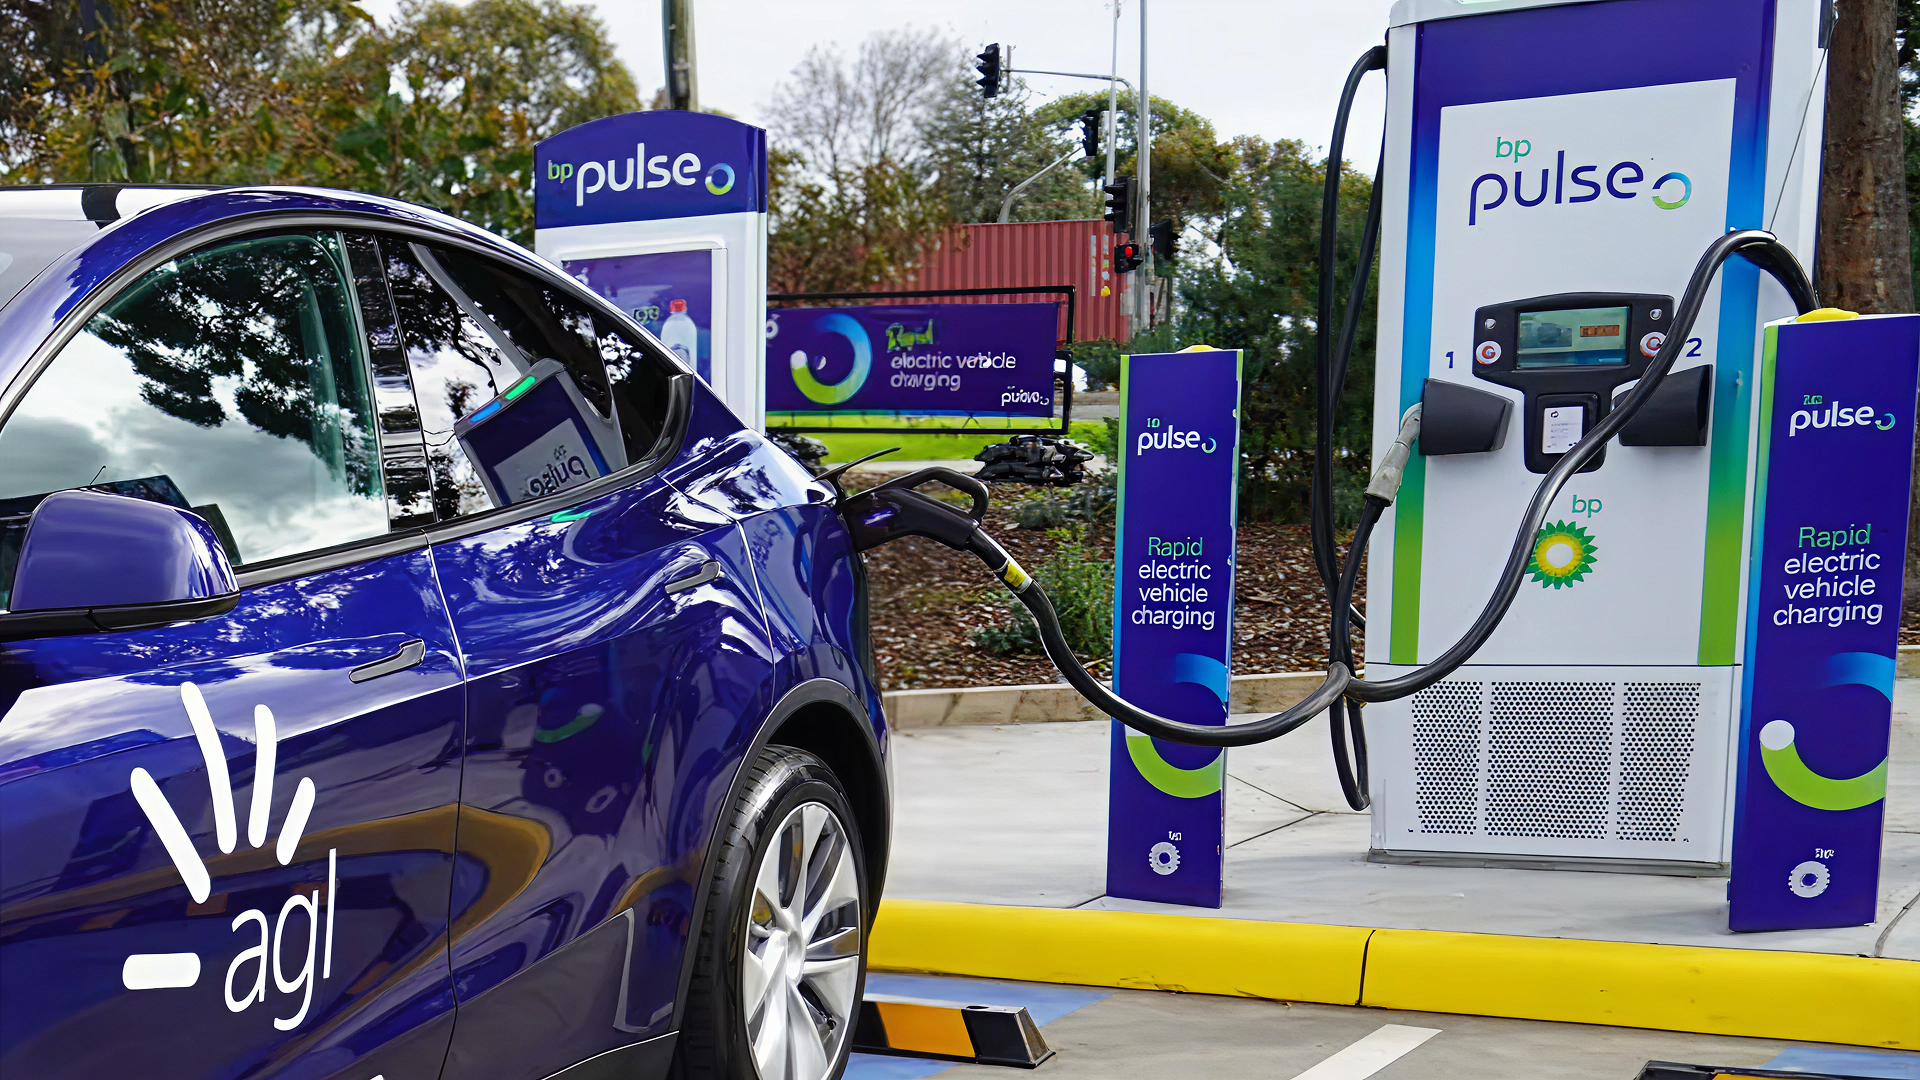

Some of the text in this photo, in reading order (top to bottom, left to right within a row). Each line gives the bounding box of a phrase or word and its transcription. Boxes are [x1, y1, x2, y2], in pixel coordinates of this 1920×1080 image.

[1496, 137, 1531, 163] bp
[548, 142, 701, 207] bp pulse
[1468, 150, 1644, 226] pulse
[1446, 351, 1454, 369] 1
[1686, 338, 1702, 357] 2
[1789, 401, 1875, 437] pulse
[1137, 425, 1200, 456] pulse
[1572, 494, 1603, 518] bp
[1148, 537, 1203, 560] Rapid
[1798, 523, 1871, 550] Rapid
[1138, 559, 1211, 579] electric
[1784, 548, 1880, 574] electric
[1138, 583, 1208, 602] vehicle
[1784, 575, 1875, 599] vehicle
[1131, 605, 1215, 630] charging
[1773, 600, 1883, 627] charging
[224, 848, 337, 1031] agl
